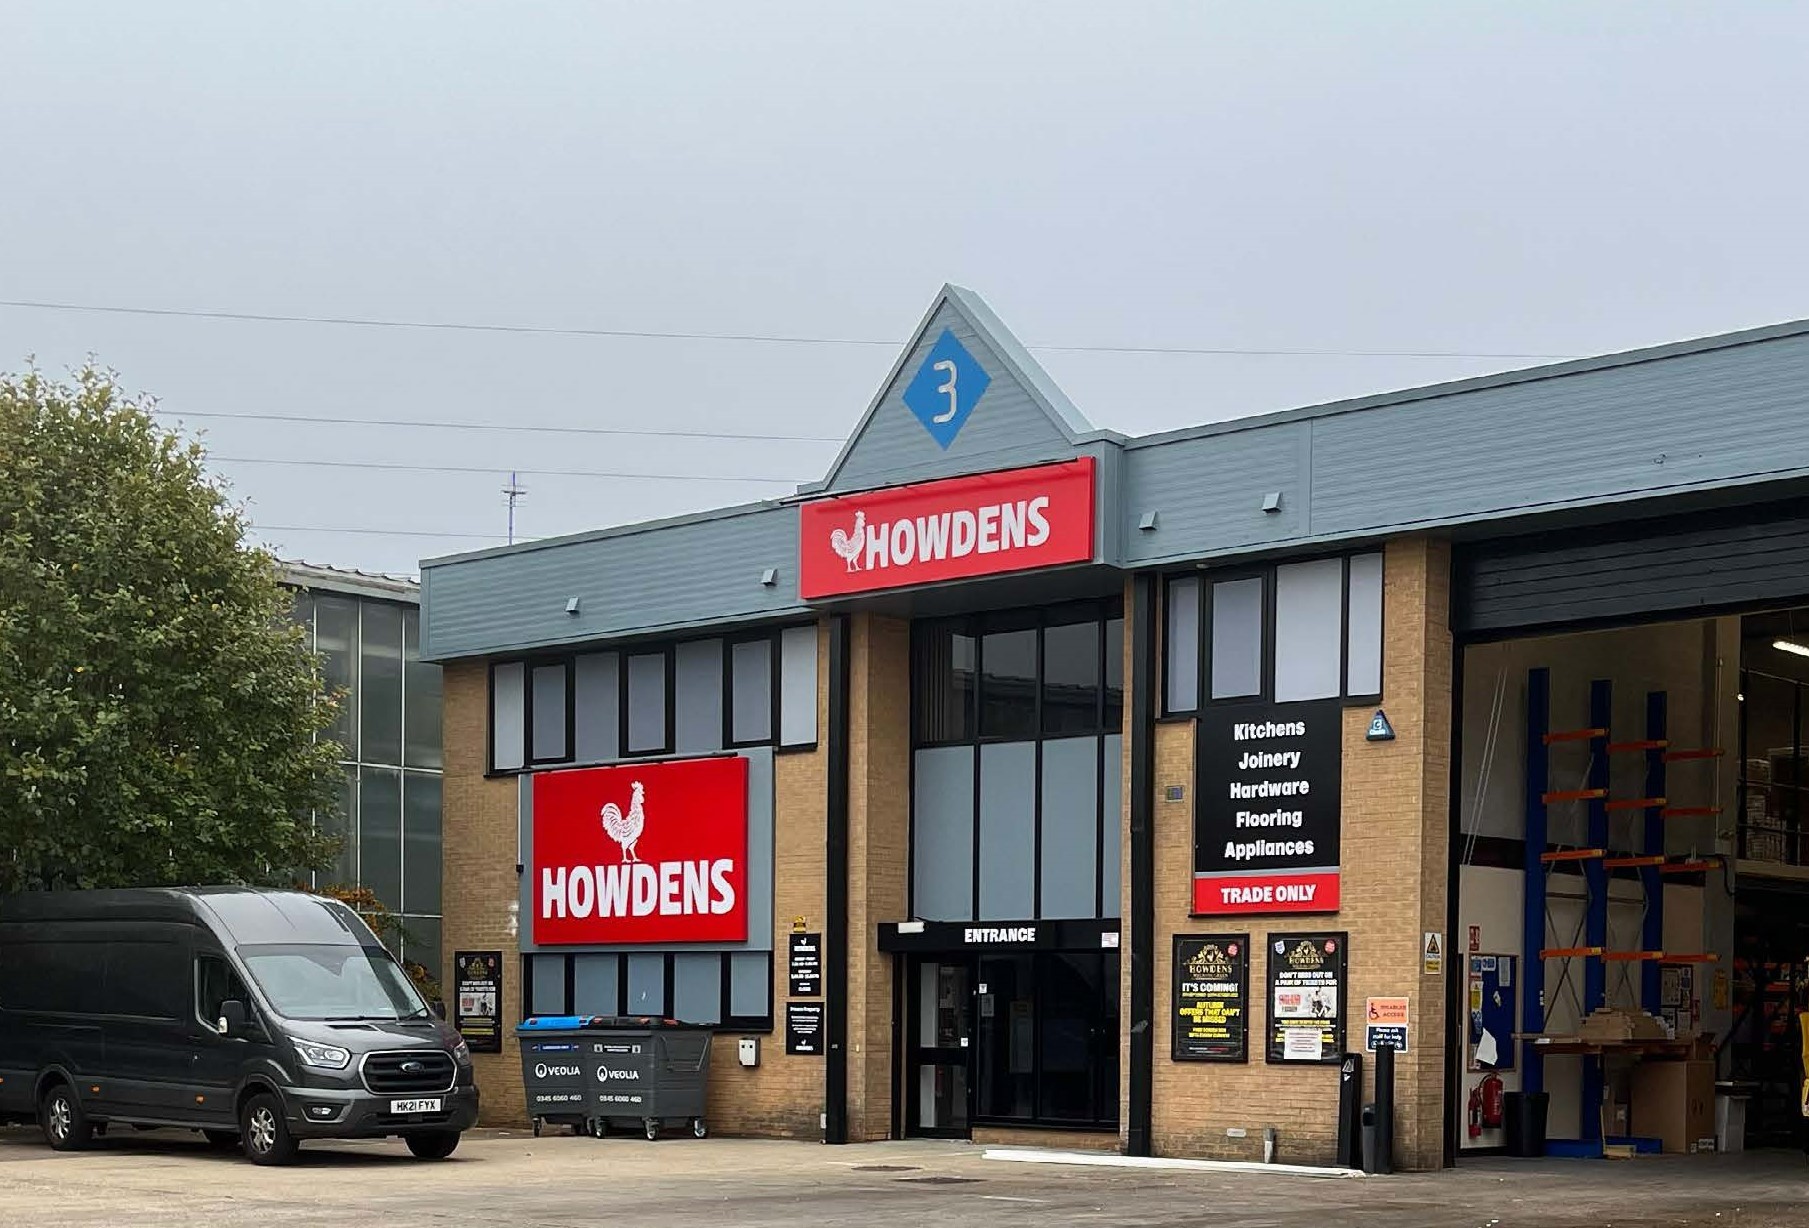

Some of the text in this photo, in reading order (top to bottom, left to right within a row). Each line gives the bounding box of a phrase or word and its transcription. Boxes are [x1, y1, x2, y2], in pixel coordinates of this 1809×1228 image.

[933, 360, 957, 424] 3
[865, 496, 1050, 571] HOWDENS
[1233, 720, 1306, 741] Kitchens
[1238, 751, 1301, 770] Joinery
[1229, 780, 1310, 799] Hardware
[1236, 808, 1303, 828] Flooring
[1224, 839, 1315, 861] Appliances
[542, 858, 735, 919] HOWDENS
[1220, 884, 1317, 904] TRADE ONLY
[964, 927, 1036, 943] ENTRANCE
[1189, 965, 1233, 974] HOWDENS
[1182, 983, 1198, 992] IT'S
[548, 1066, 581, 1076] VEOLIA
[608, 1070, 639, 1080] VEOLIA
[397, 1100, 436, 1111] HK21 FYX
